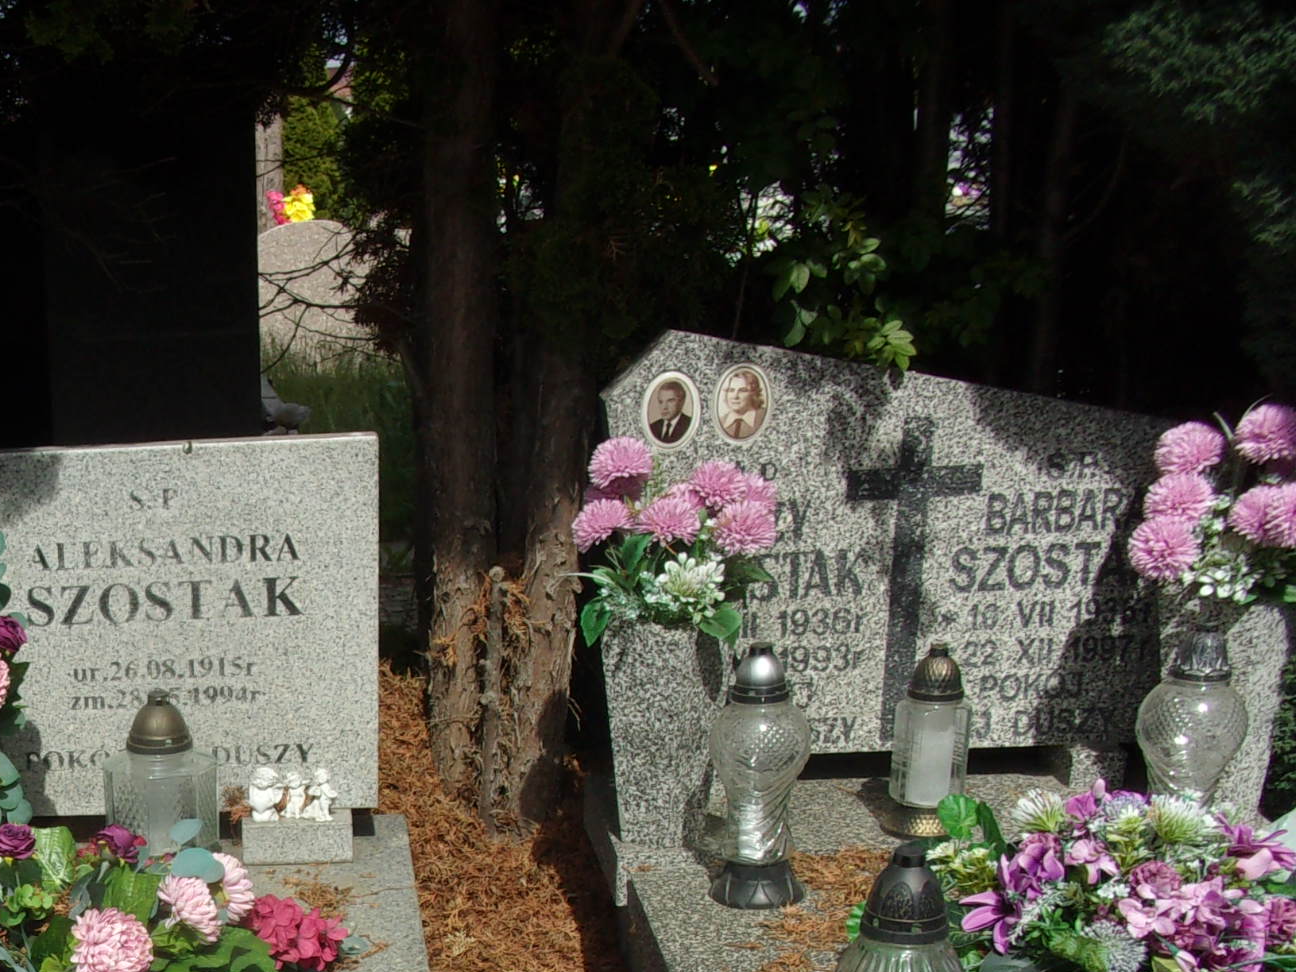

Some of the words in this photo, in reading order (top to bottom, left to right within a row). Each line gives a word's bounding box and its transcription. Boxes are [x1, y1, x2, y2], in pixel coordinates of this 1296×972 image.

[31, 532, 301, 572] ALEKSANDRA
[751, 548, 863, 600] STAK
[951, 540, 1132, 592] SZOSTA
[26, 575, 304, 629] SZOSTAK
[25, 744, 111, 772] POKÓ
[212, 743, 314, 767] DUSZY
